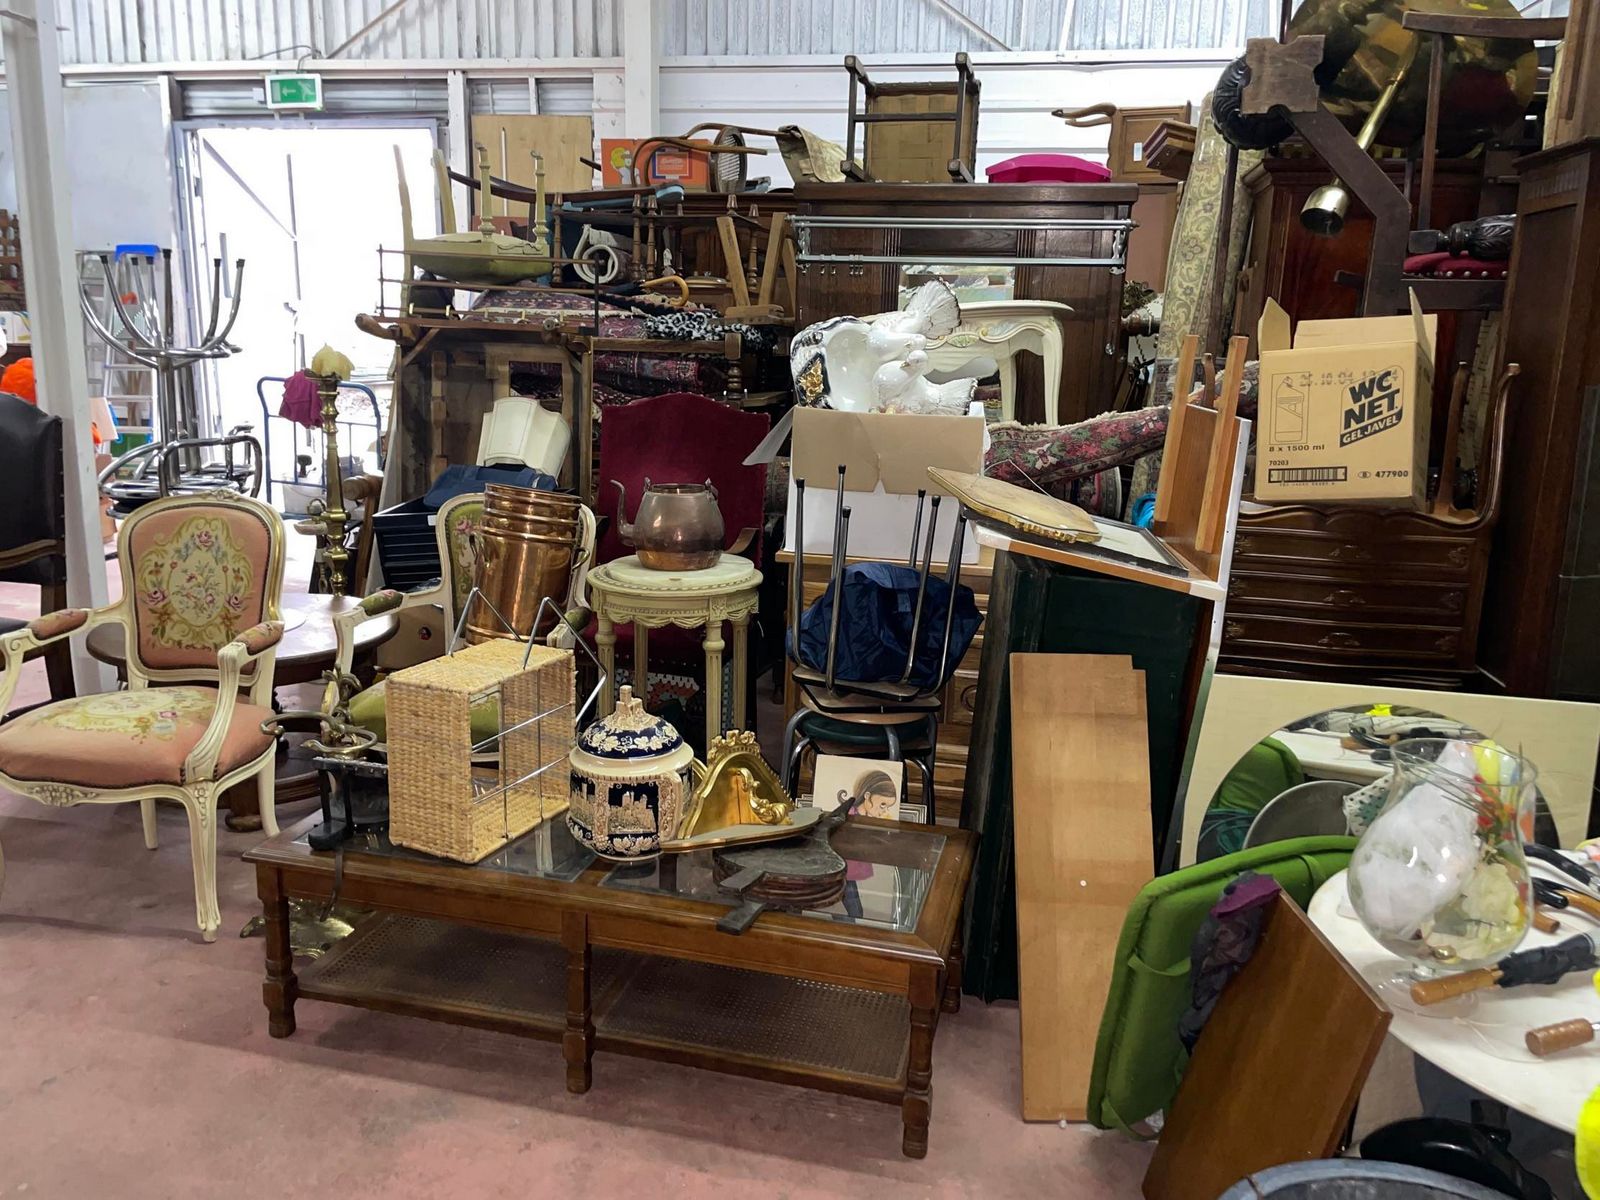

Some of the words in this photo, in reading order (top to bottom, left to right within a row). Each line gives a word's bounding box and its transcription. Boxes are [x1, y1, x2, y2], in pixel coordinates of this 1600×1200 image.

[1348, 370, 1392, 404] WC
[1344, 388, 1400, 430] NET
[1342, 429, 1363, 443] GEL
[1364, 415, 1399, 435] JAVEL
[1287, 444, 1310, 452] 1500
[1312, 443, 1325, 451] ml
[1375, 470, 1409, 478] 477900
